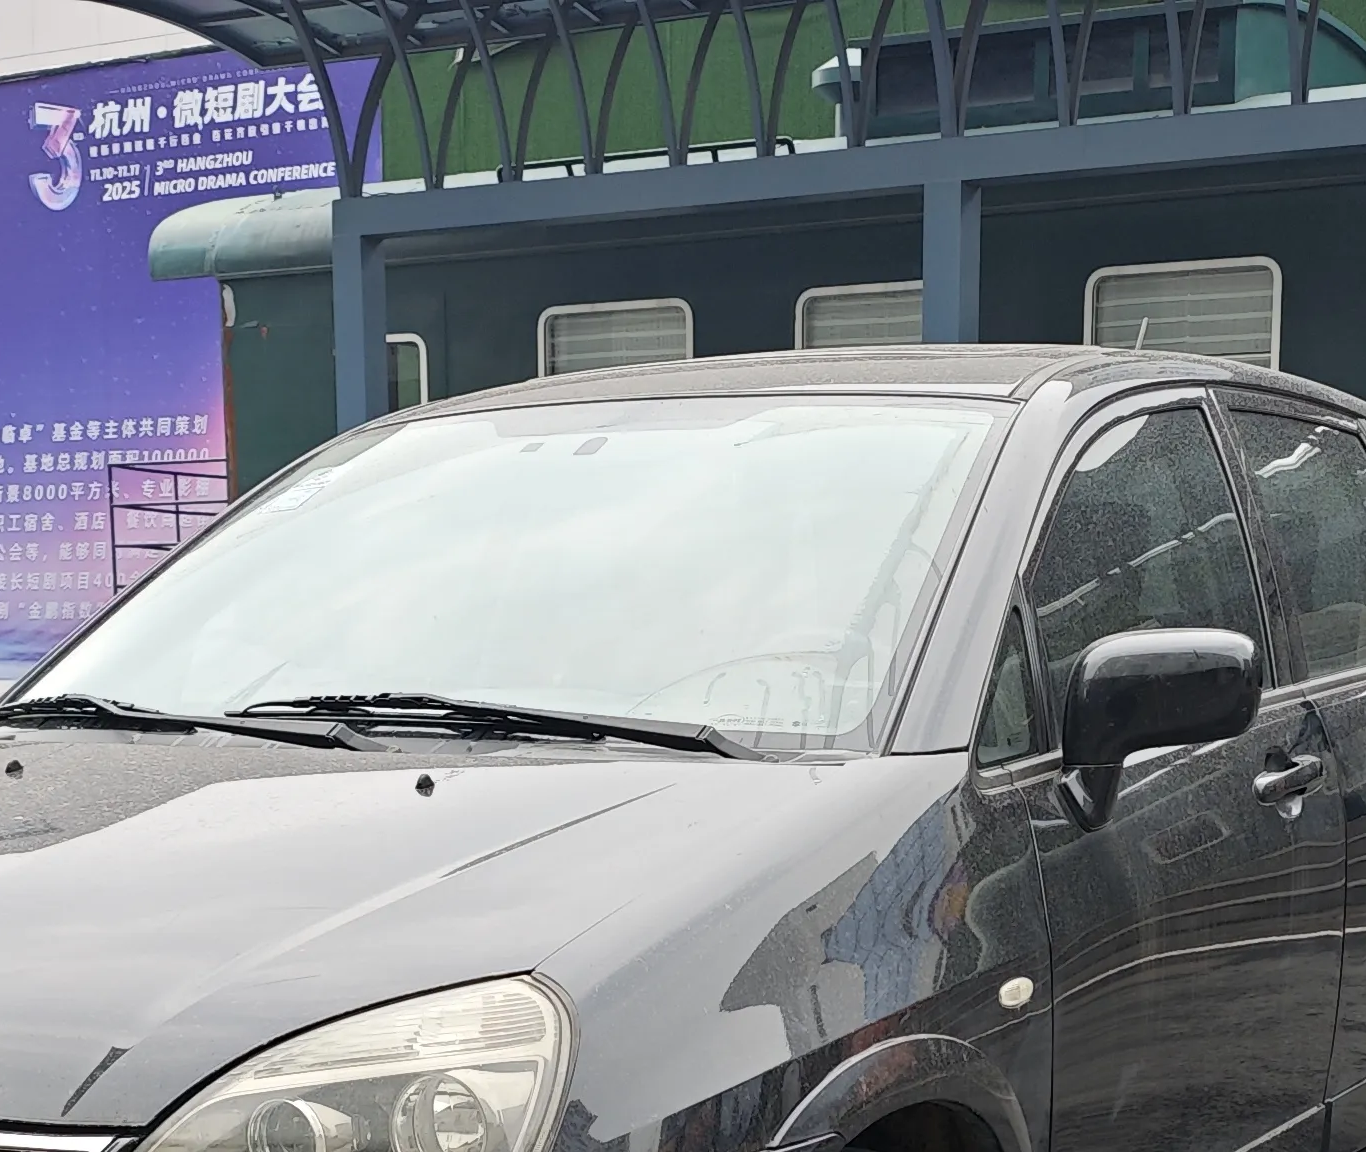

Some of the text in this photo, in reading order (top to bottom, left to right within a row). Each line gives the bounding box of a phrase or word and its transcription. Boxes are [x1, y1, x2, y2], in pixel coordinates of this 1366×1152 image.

[89, 73, 325, 139] 杭州·微短剧大会
[28, 102, 82, 211] 3
[177, 150, 253, 173] HANGZHOU
[102, 180, 140, 202] 2025
[153, 161, 337, 197] MICRO DRAMA CONFERENCE
